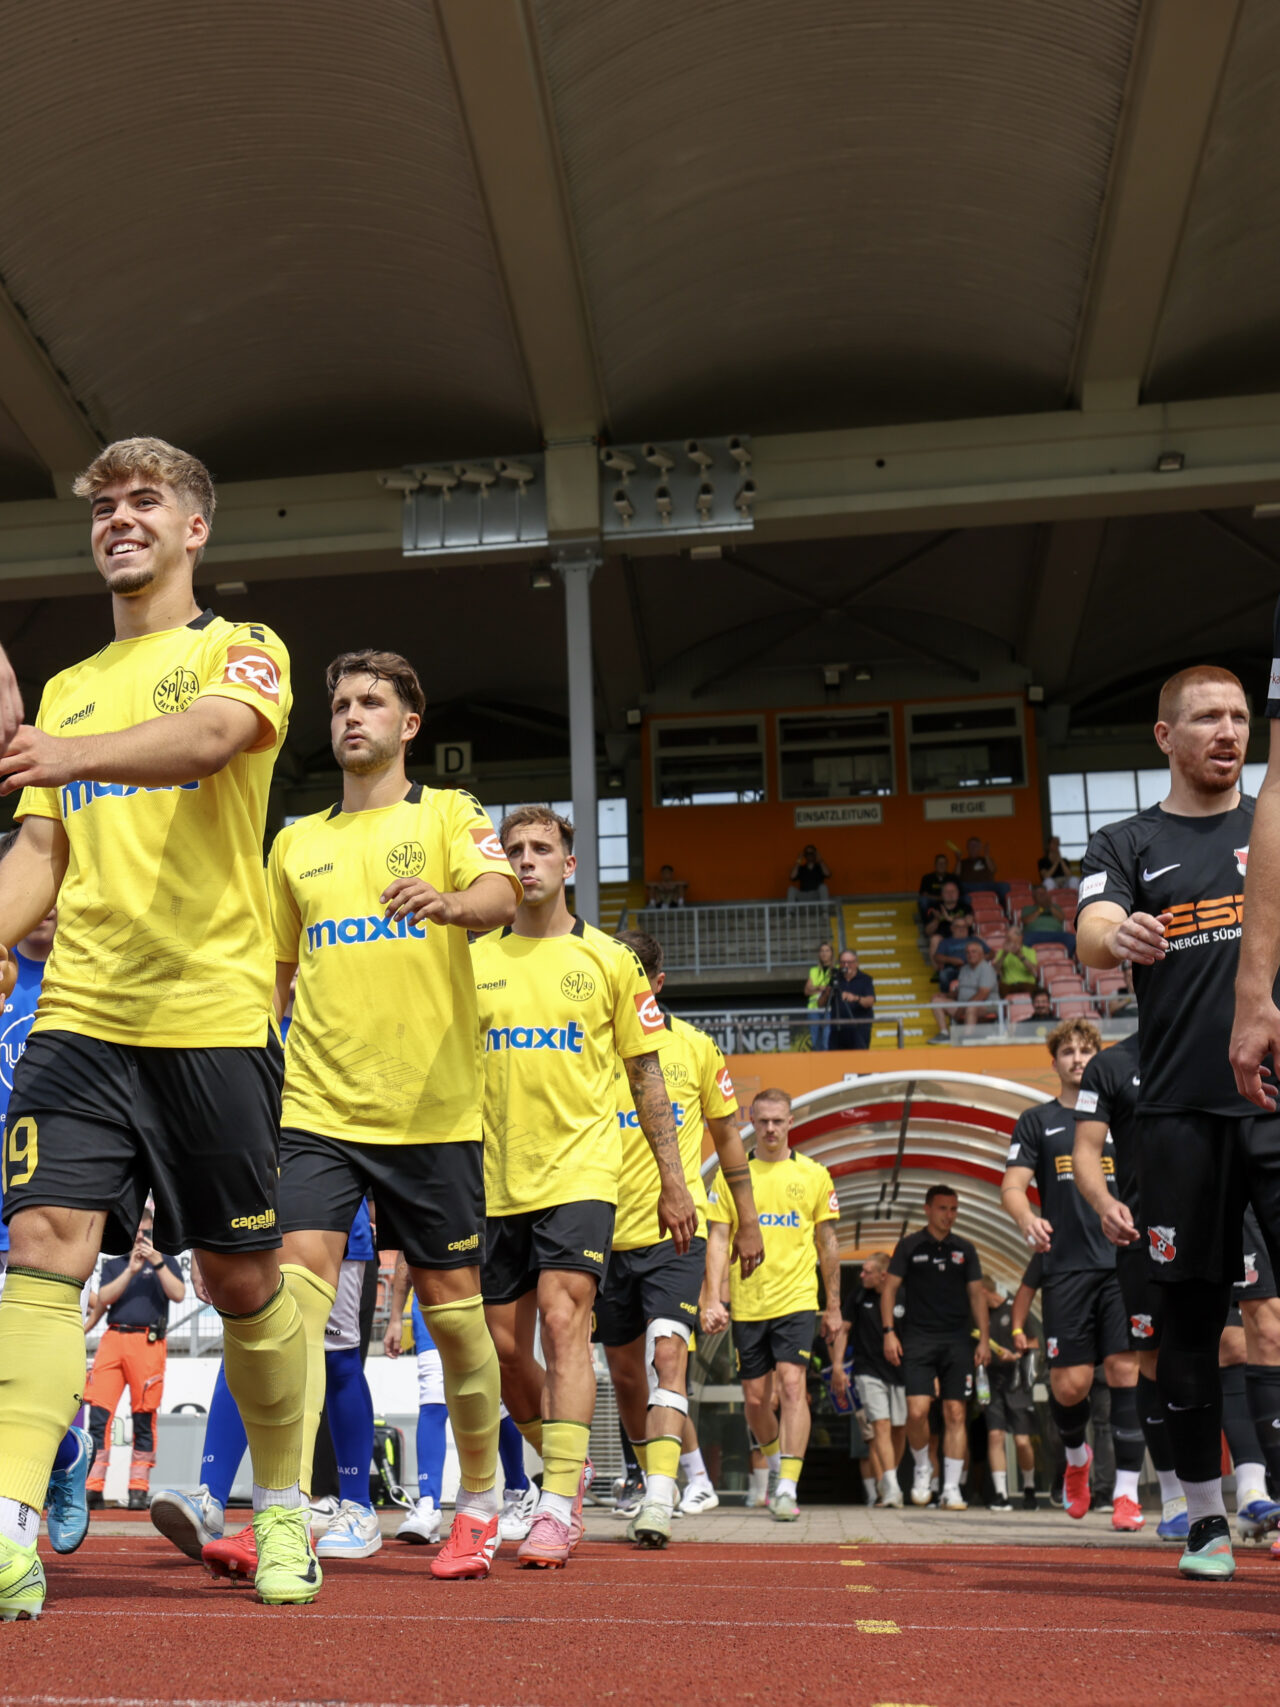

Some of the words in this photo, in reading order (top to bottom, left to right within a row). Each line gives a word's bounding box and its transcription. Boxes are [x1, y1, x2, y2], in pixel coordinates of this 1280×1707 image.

[158, 695, 194, 713] BAYREUTH
[60, 701, 96, 729] capelli
[444, 746, 464, 773] D
[796, 807, 879, 823] EINSATZLEITUNG
[950, 801, 986, 814] REGIE
[299, 863, 334, 880] capelli
[476, 978, 507, 991] capelli
[485, 1021, 585, 1054] maxit
[717, 1030, 791, 1052] UNGE
[1055, 1155, 1115, 1174] EB
[230, 1208, 276, 1230] capelli
[252, 1221, 276, 1231] SPORT
[758, 1210, 800, 1228] axit
[447, 1233, 479, 1251] capelli
[17, 1502, 30, 1531] SIGN
